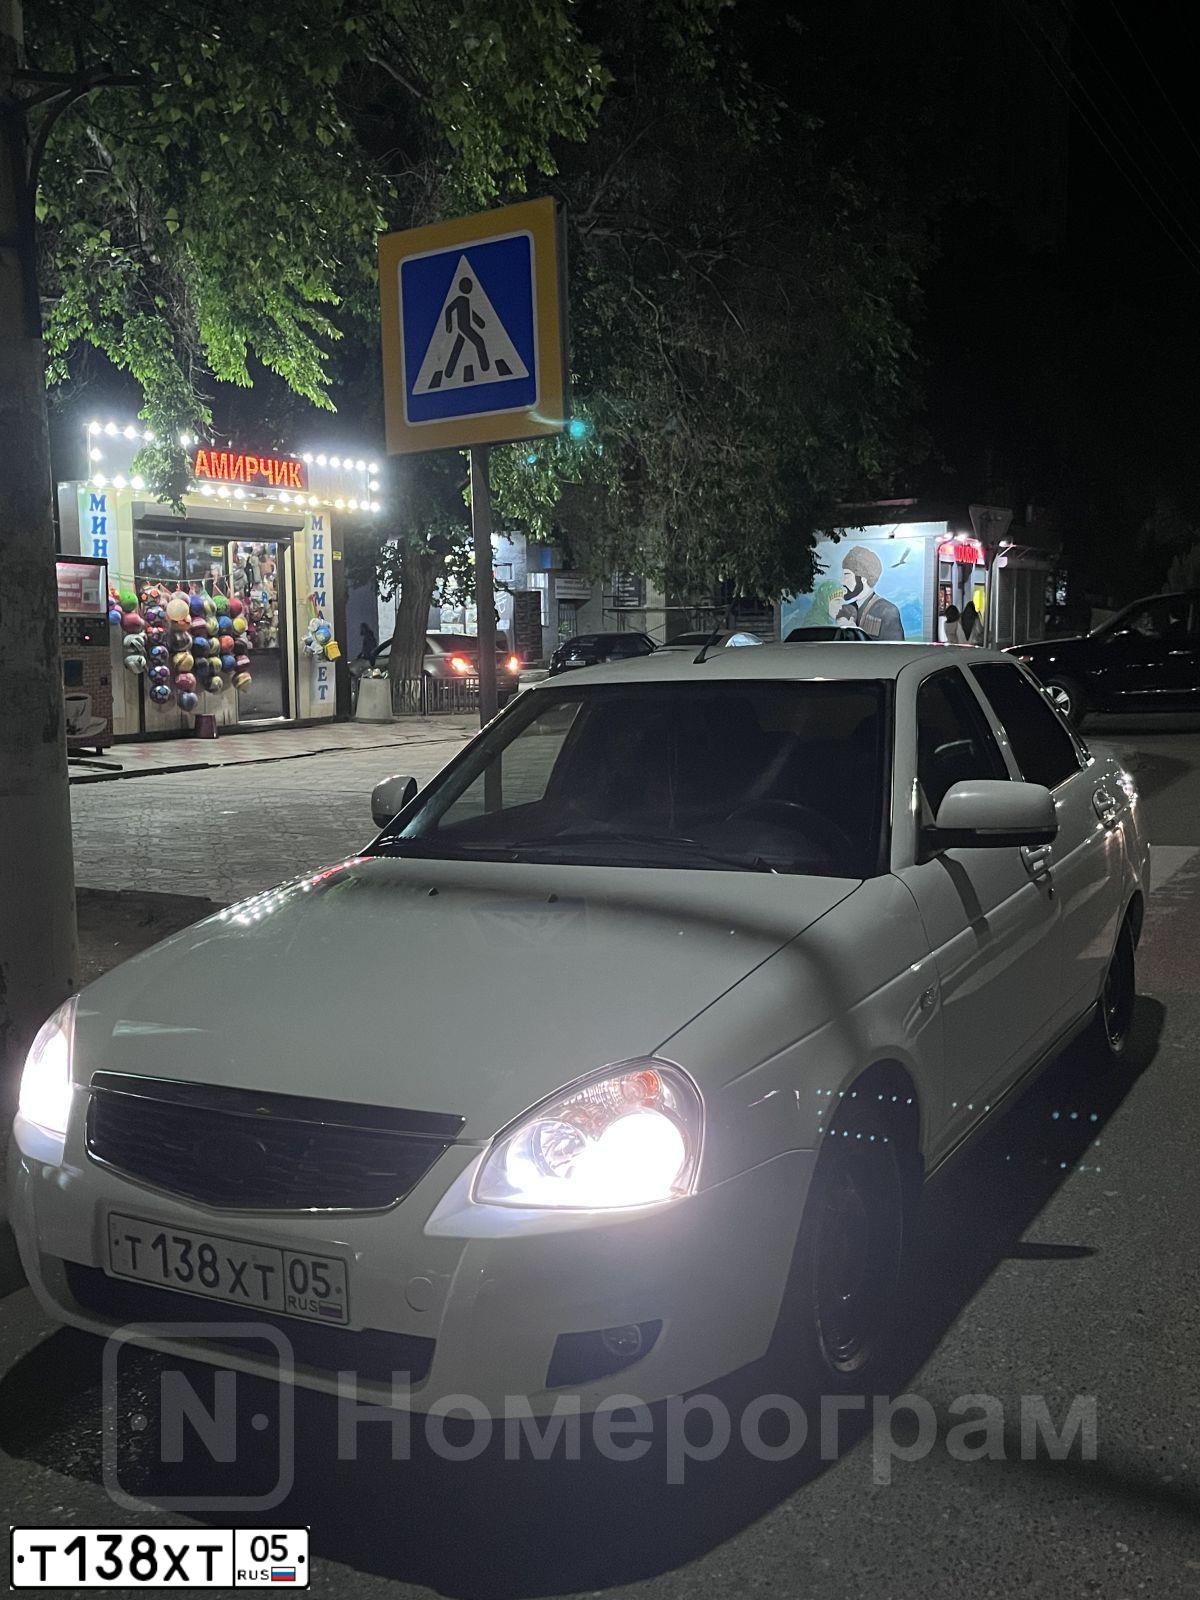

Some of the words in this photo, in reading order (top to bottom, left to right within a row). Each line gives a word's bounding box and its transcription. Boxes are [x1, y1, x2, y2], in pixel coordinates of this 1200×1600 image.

[194, 448, 303, 489] АМИРЧИК
[311, 515, 328, 700] МИНИМЕТ
[124, 1231, 275, 1302] Т138ХТ
[289, 1258, 331, 1299] 05
[287, 1296, 318, 1313] RUS
